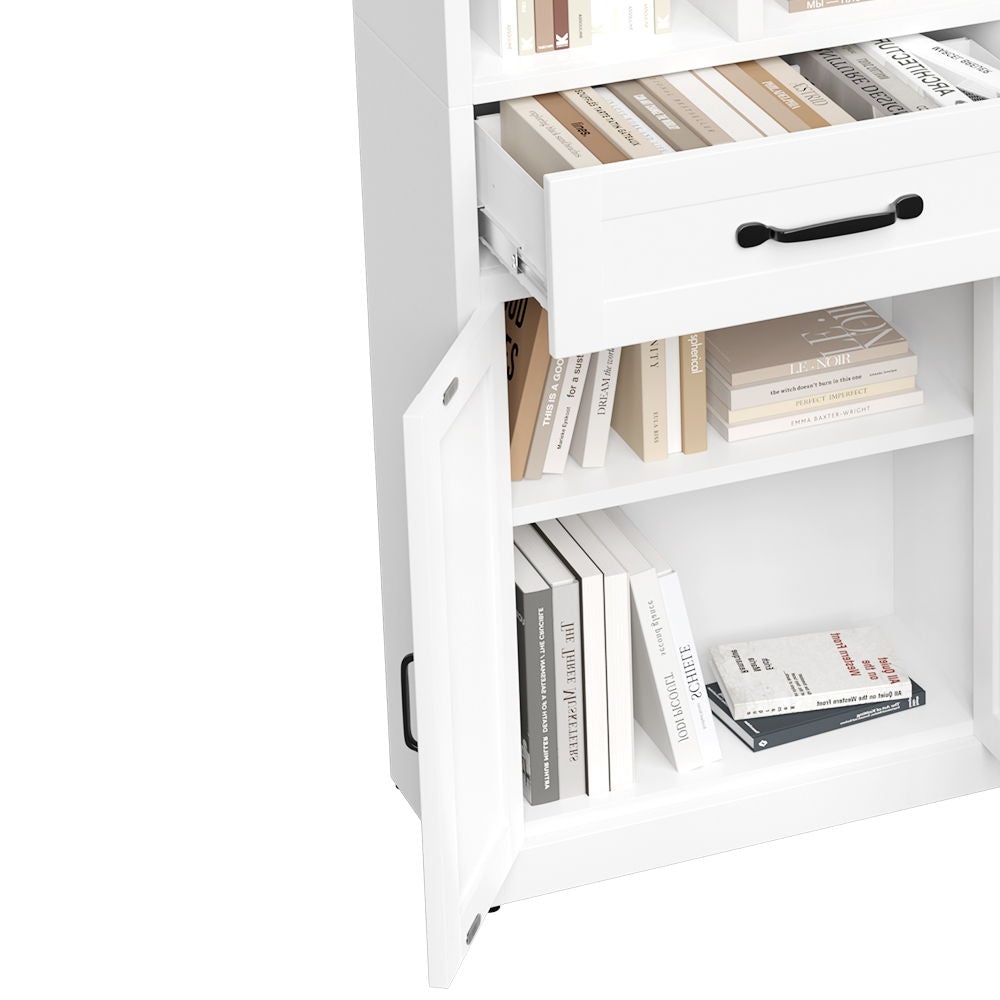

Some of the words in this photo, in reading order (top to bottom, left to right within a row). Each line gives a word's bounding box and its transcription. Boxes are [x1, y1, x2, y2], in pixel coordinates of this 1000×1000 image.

[806, 0, 824, 9] МЫ
[687, 334, 703, 375] spherical
[789, 362, 809, 375] LE
[815, 353, 851, 370] NOIR
[549, 392, 557, 403] IS
[551, 383, 559, 392] A
[567, 385, 576, 399] for
[597, 378, 611, 416] DREAM
[604, 367, 612, 377] the
[780, 386, 797, 394] witch
[797, 382, 818, 391] doesn't
[795, 396, 826, 407] PERFECT
[829, 387, 868, 401] IMPERFECT
[542, 403, 555, 427] THIS
[790, 417, 811, 426] EMMA
[813, 405, 871, 422] BAXTER-WRIGHT
